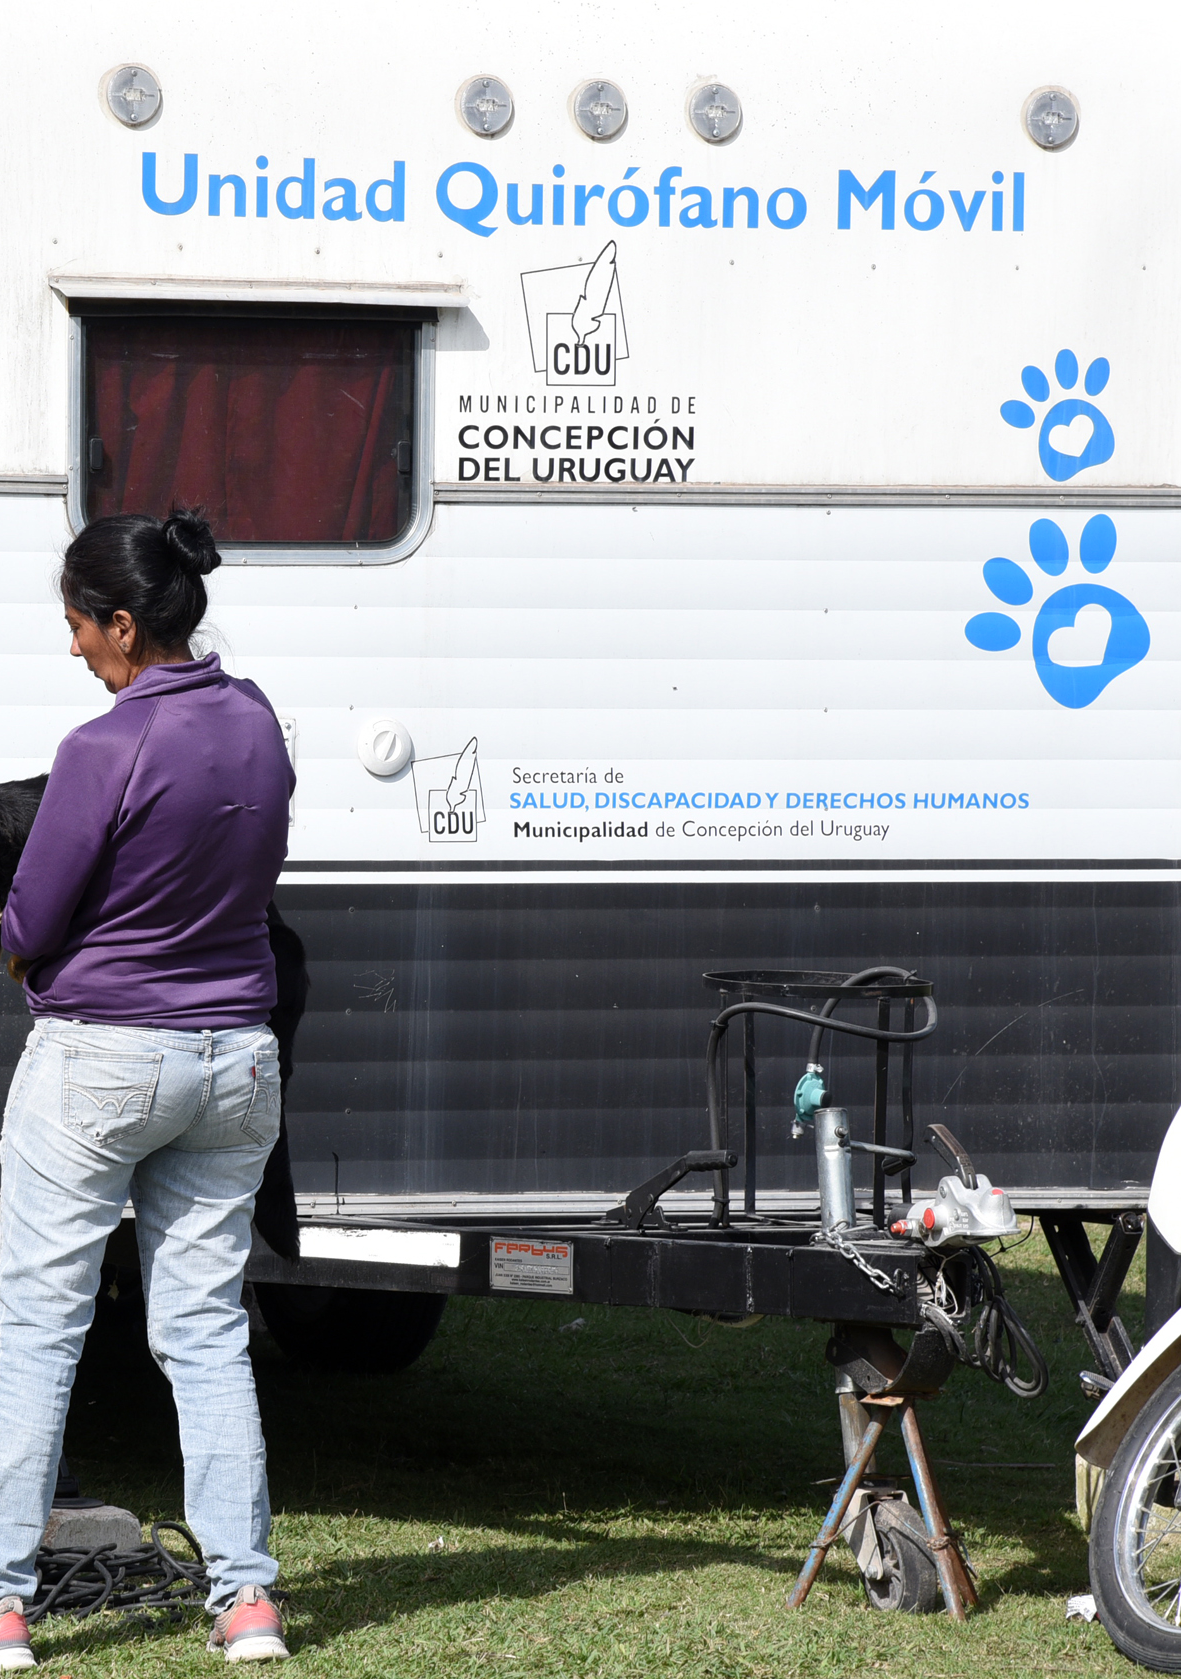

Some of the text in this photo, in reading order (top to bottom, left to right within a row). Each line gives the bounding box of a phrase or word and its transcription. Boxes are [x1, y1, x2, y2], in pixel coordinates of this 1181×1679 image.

[141, 151, 1026, 238] Unidad Quirófano Móvil
[553, 342, 612, 376] CDU
[459, 395, 696, 414] MUNICIPALIDAD DE
[458, 418, 695, 450] CONCEPCIÓN
[459, 457, 696, 483] DEL URUGUAY
[512, 767, 624, 784] Secretaría de
[509, 792, 589, 813] SALUD,
[594, 792, 762, 810] DISCAPACIDAD
[785, 792, 907, 810] DERECHOS
[913, 792, 1031, 810] HUMANOS
[433, 811, 474, 835] CDU
[513, 820, 890, 842] Municipalidad de Concepción del Uruguay
